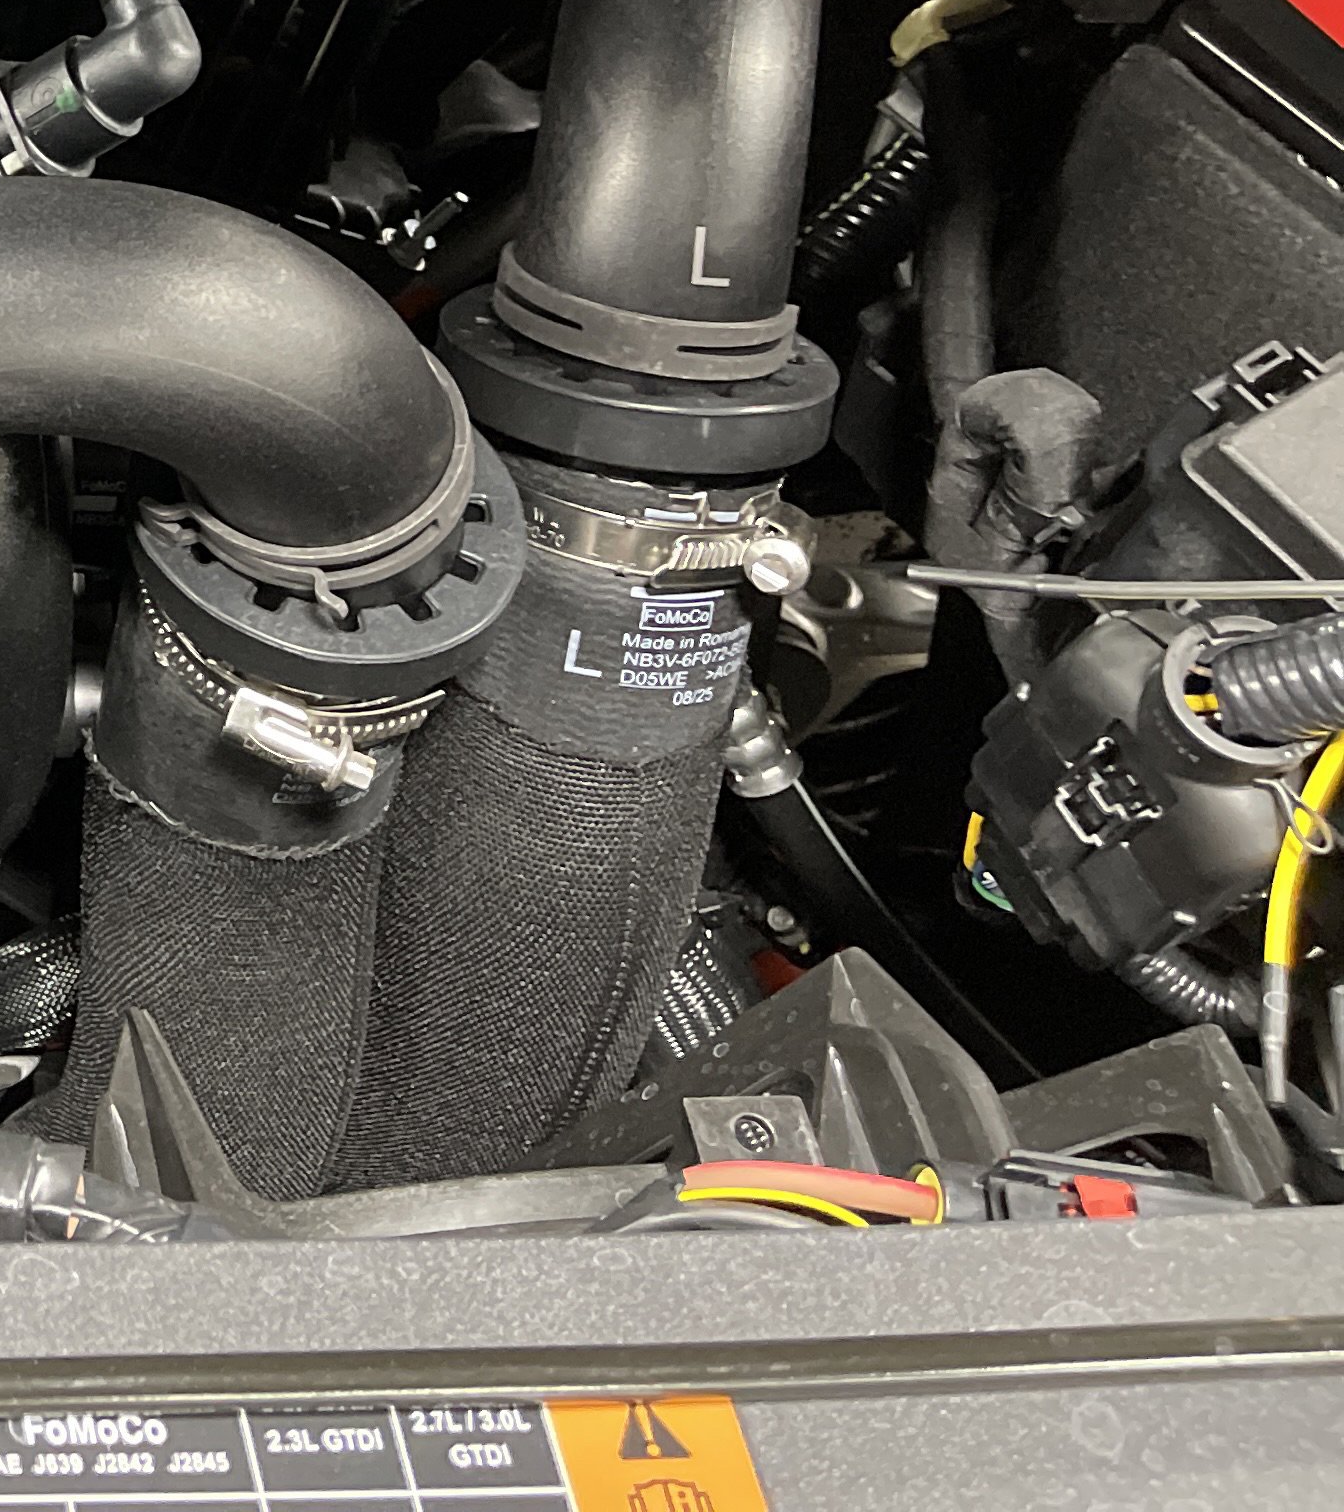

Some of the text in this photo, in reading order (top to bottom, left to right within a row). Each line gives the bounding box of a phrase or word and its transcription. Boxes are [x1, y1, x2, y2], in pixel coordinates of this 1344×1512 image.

[691, 225, 731, 287] L
[643, 607, 710, 625] FoMoCo
[564, 628, 603, 678] L
[621, 632, 675, 651] Made
[679, 633, 694, 649] in
[23, 1414, 168, 1446] FoMoCo
[410, 1410, 463, 1433] 2.7L
[477, 1408, 532, 1432] 3.0L
[264, 1427, 385, 1453] 2.3L GTDI
[93, 1451, 156, 1475] J2842
[167, 1450, 231, 1474] J2845
[448, 1442, 513, 1468] GTDI
